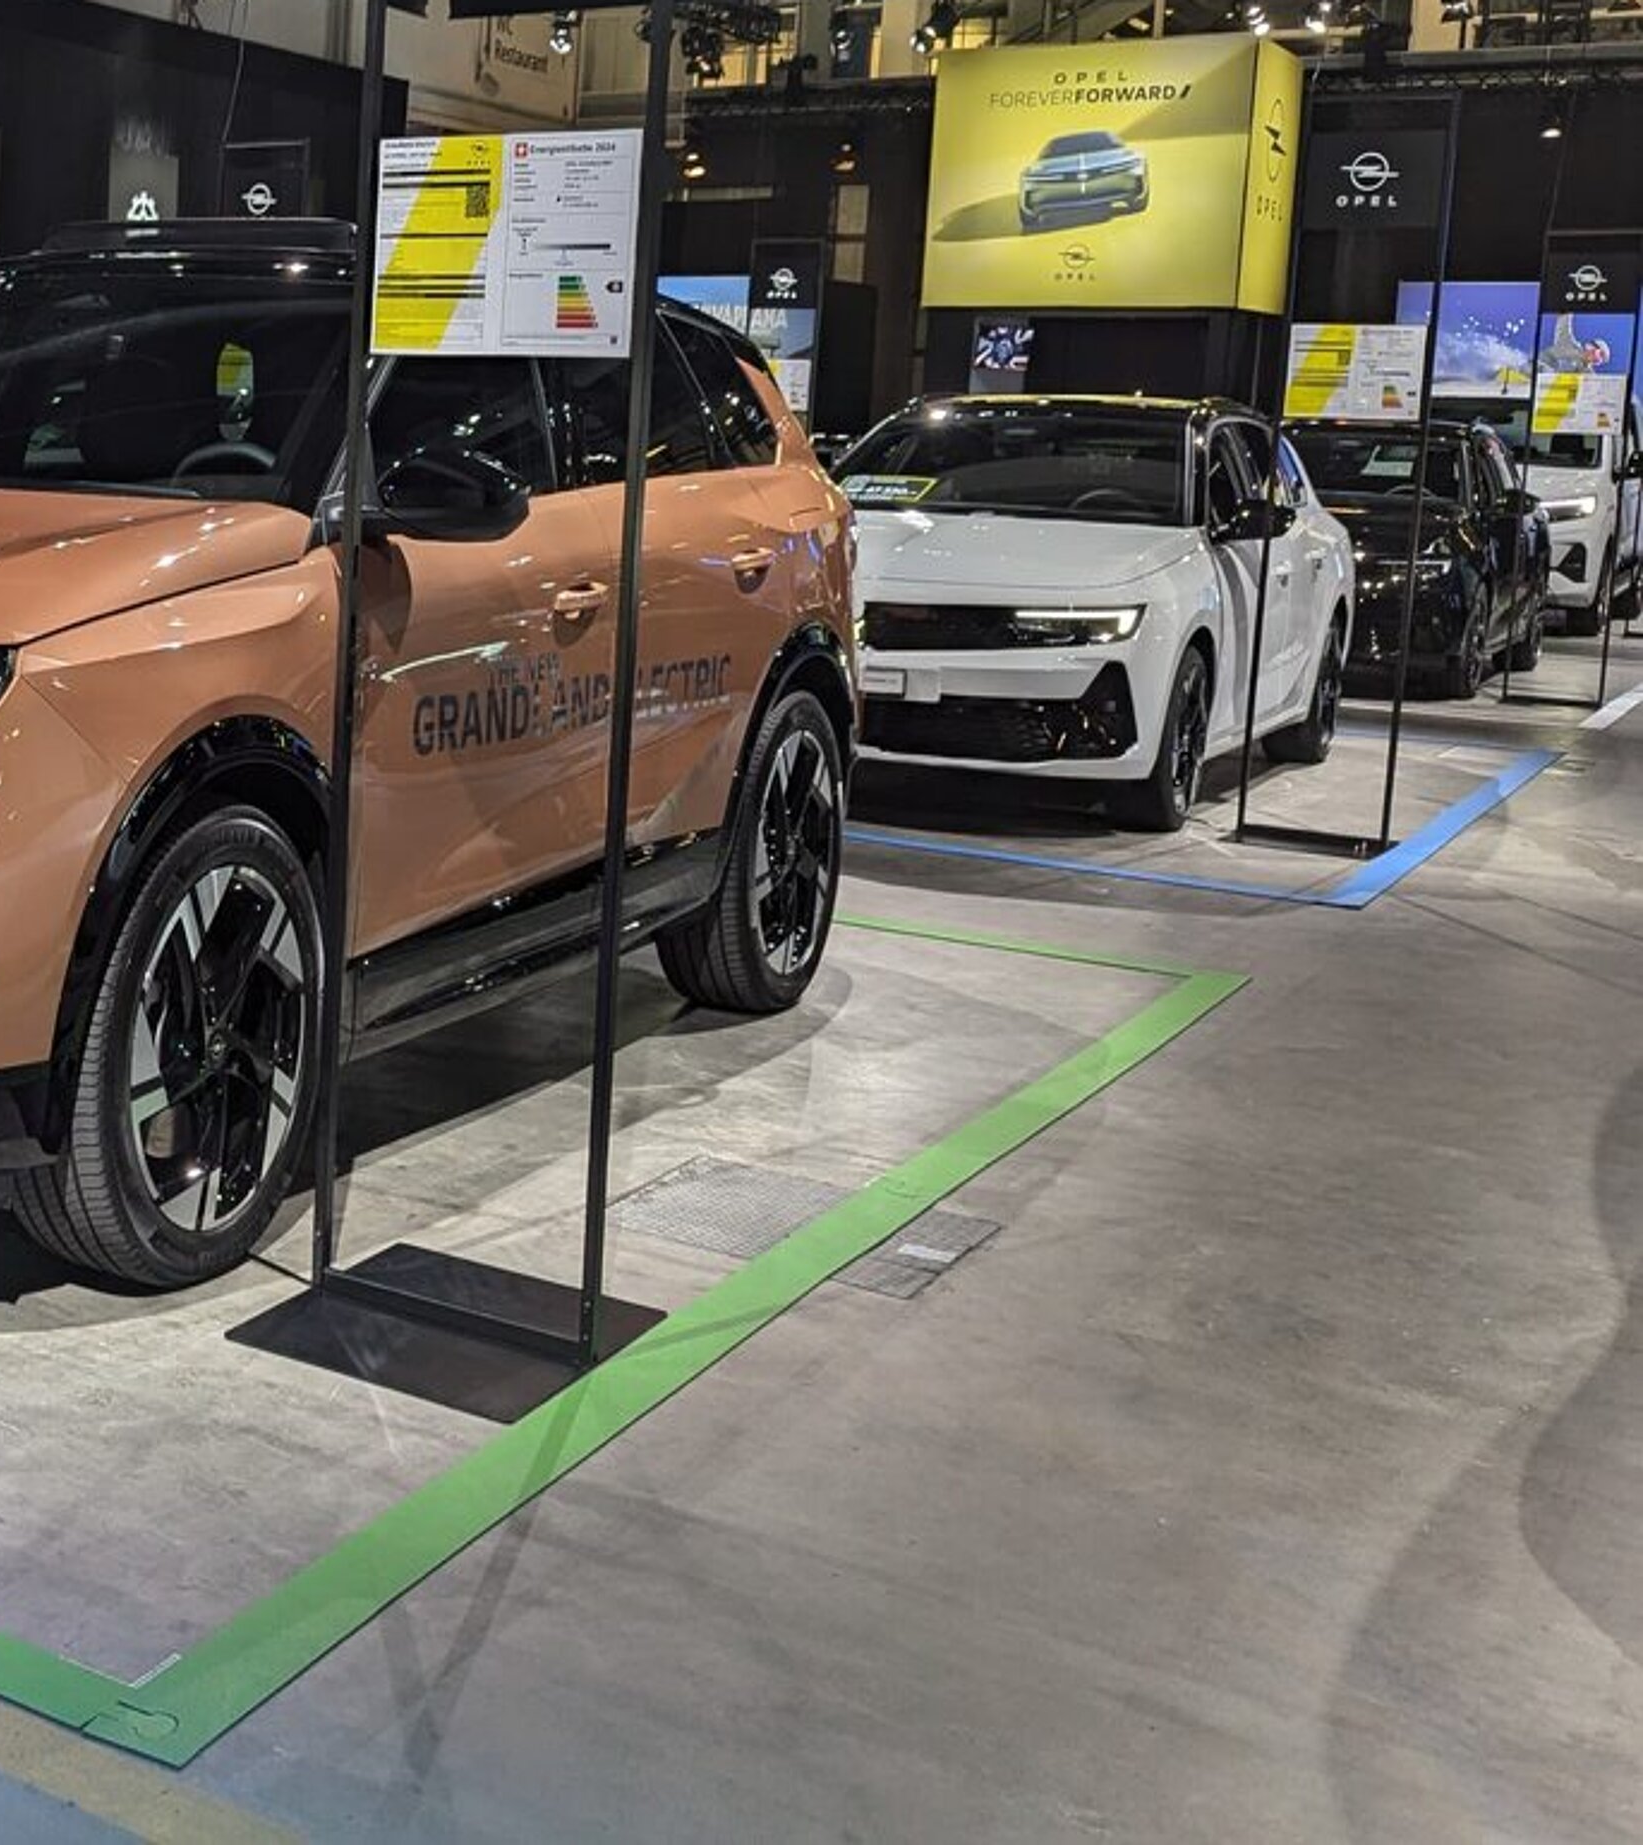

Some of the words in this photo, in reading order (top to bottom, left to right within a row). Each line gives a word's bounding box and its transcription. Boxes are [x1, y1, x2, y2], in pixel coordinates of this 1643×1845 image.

[1054, 70, 1128, 84] OPEL
[1336, 195, 1398, 207] OPEL
[1256, 195, 1283, 222] OPEL
[1054, 272, 1096, 281] OPEL
[1565, 292, 1607, 301] OPEL
[636, 652, 730, 706] LECTRIC
